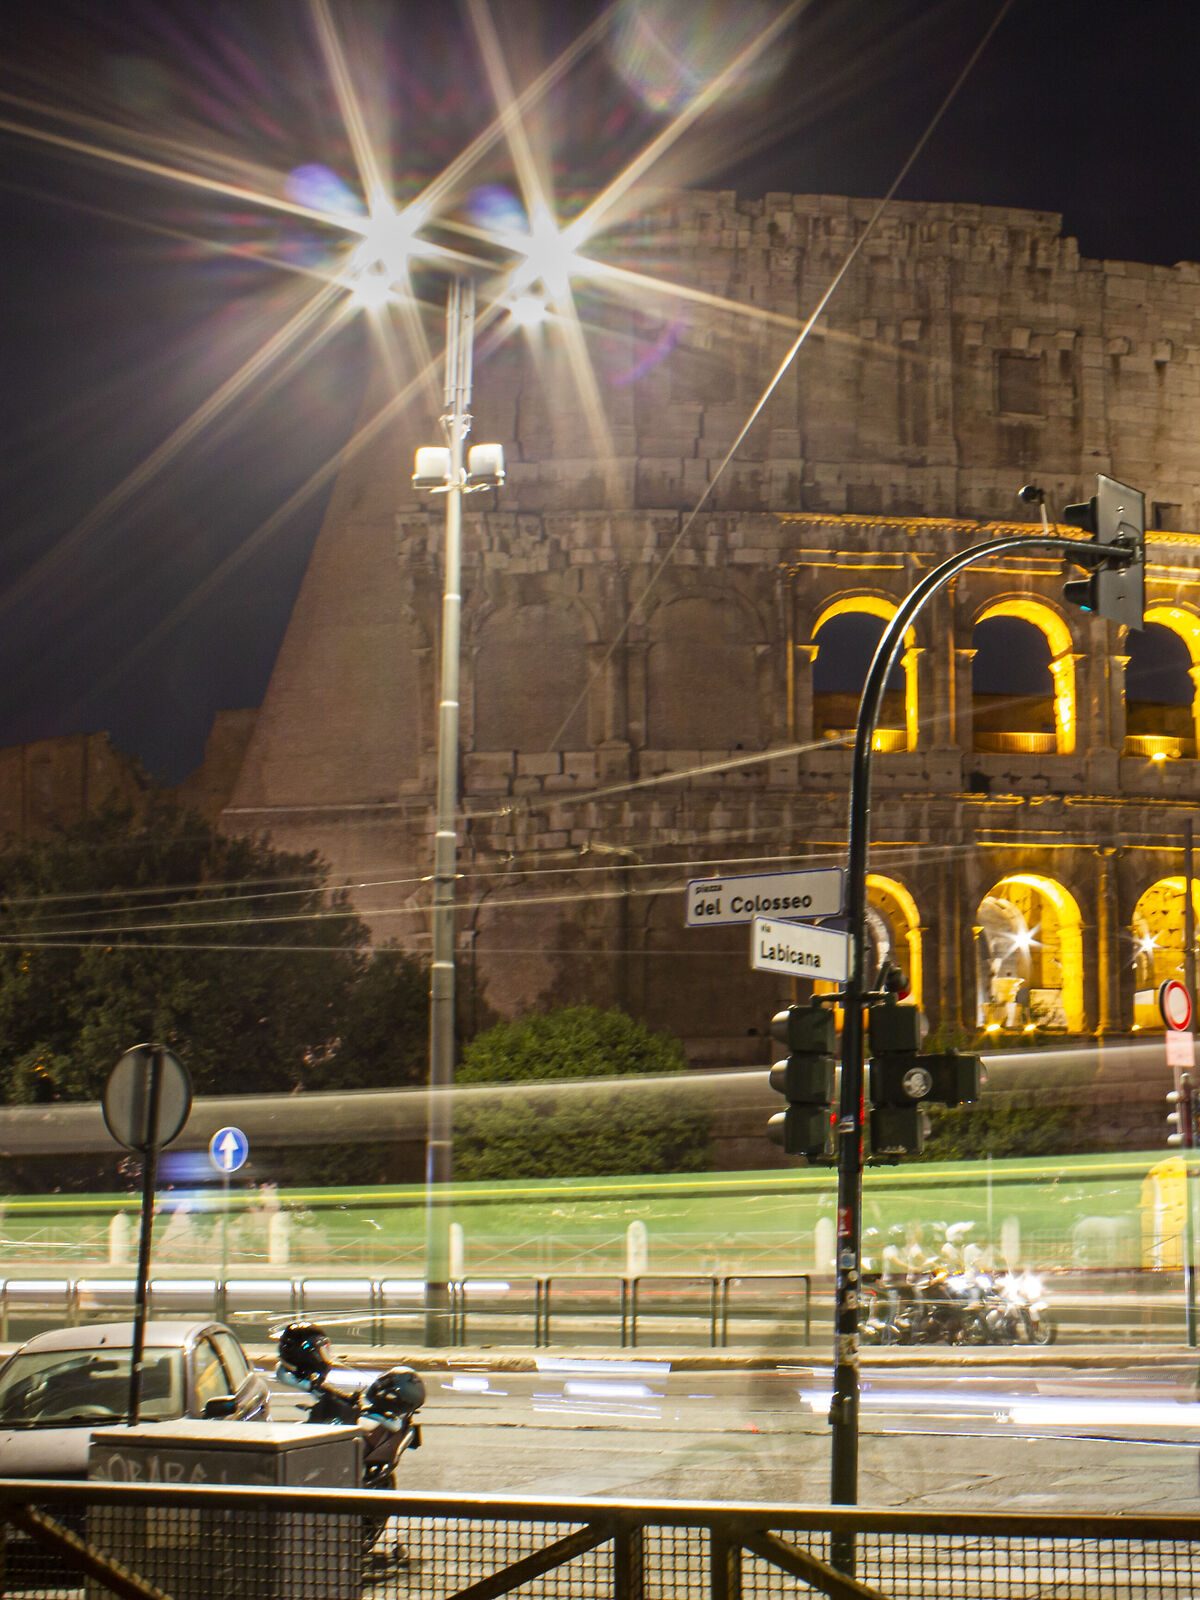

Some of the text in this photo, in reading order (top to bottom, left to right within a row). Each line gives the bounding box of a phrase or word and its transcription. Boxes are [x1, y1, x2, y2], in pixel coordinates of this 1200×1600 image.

[695, 883, 723, 895] piazza
[694, 894, 813, 917] del Colosseo
[760, 923, 771, 933] via
[760, 940, 822, 969] Labicana
